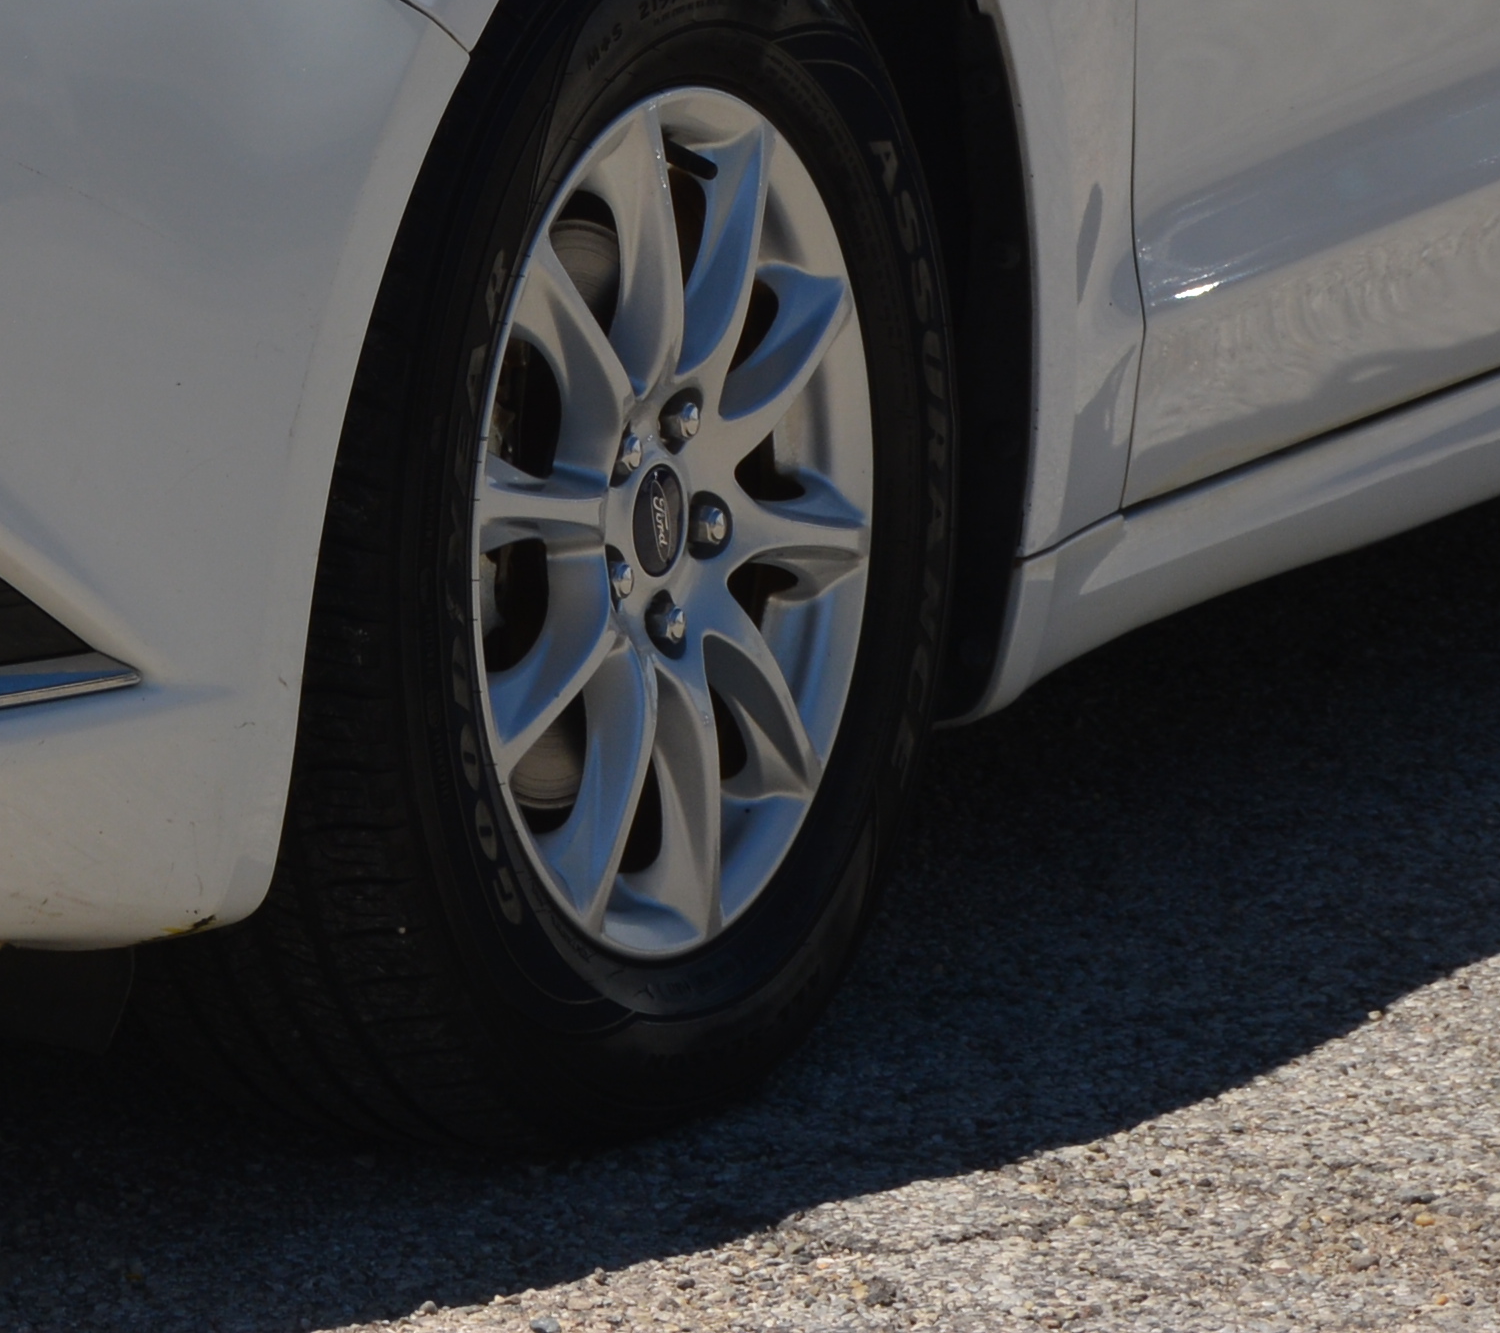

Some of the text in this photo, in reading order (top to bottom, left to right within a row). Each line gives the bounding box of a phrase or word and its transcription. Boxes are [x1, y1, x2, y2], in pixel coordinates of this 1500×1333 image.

[586, 22, 624, 72] M+S
[444, 247, 525, 926] GOODYEAR
[652, 495, 670, 548] Ford
[868, 138, 949, 792] ASSURANCE
